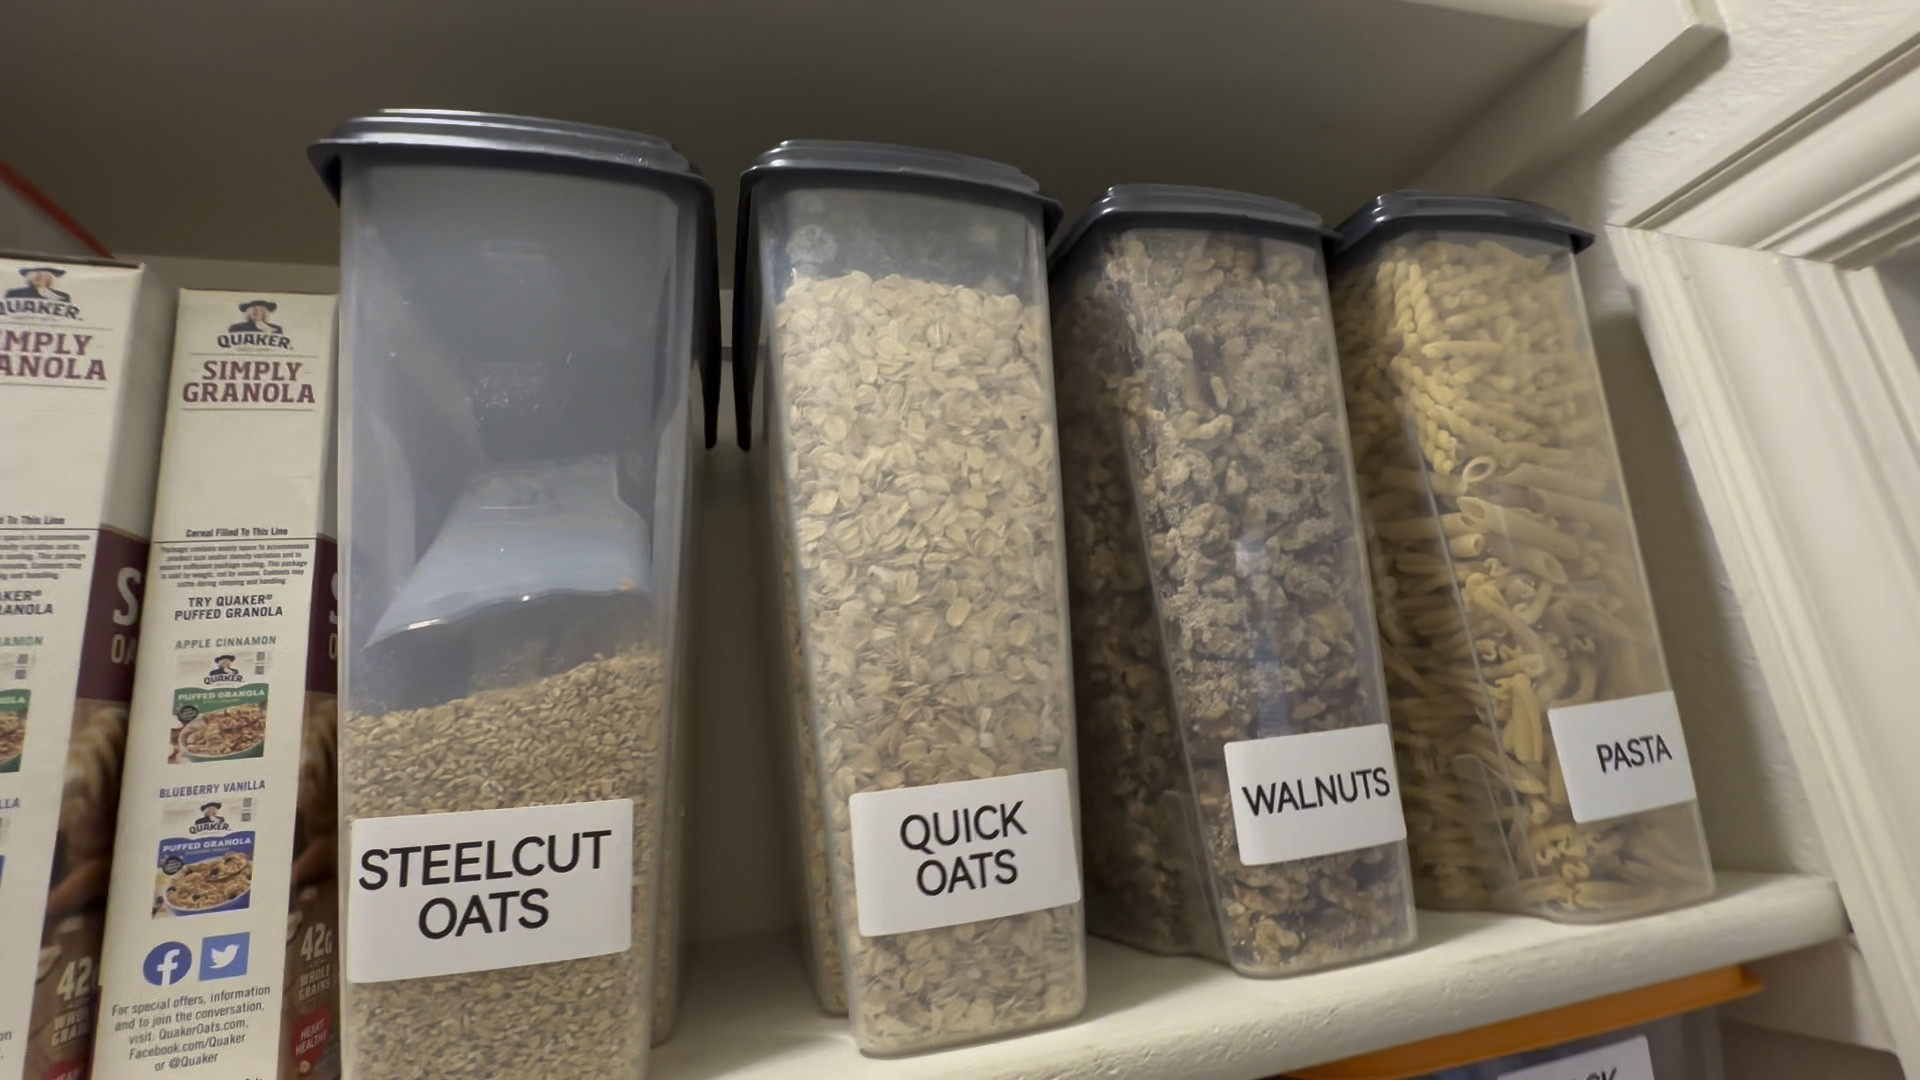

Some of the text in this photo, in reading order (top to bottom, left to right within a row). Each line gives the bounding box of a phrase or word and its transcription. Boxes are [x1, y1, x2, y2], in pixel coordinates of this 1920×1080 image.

[0, 330, 92, 355] MPLY
[217, 333, 290, 349] QUAKER
[0, 353, 107, 381] ANOLA
[202, 360, 303, 381] SIMPLY
[182, 382, 316, 403] GRANOLA
[186, 527, 288, 538] Cereal Filled To This Line
[188, 596, 212, 608] TRY
[174, 606, 283, 621] PUFFED GRANOLA
[174, 635, 277, 650] APPLE CINNAMON
[204, 674, 243, 685] QUAKER
[178, 692, 215, 701] PUFFED
[217, 689, 265, 699] GRANOLA
[1596, 733, 1673, 774] PASTA
[159, 779, 266, 799] BLUEBERRY VANILLA
[1241, 766, 1391, 817] WALNUTS
[189, 822, 229, 834] QUAKER
[900, 800, 1028, 855] QUICK
[162, 842, 200, 852] PUFFED
[203, 837, 251, 848] GRANOLA
[358, 829, 612, 891] STEELCUT
[916, 848, 1018, 896] OATS
[418, 887, 549, 940] OATS
[112, 1004, 130, 1017] For
[131, 998, 170, 1015] special
[210, 985, 271, 1003] information
[114, 1018, 135, 1032] and
[138, 1017, 149, 1028] to
[152, 1014, 172, 1028] join
[175, 1011, 192, 1023] the
[128, 1033, 246, 1061] Facebook.com/Quaker
[154, 1053, 218, 1072] or @Quaker
